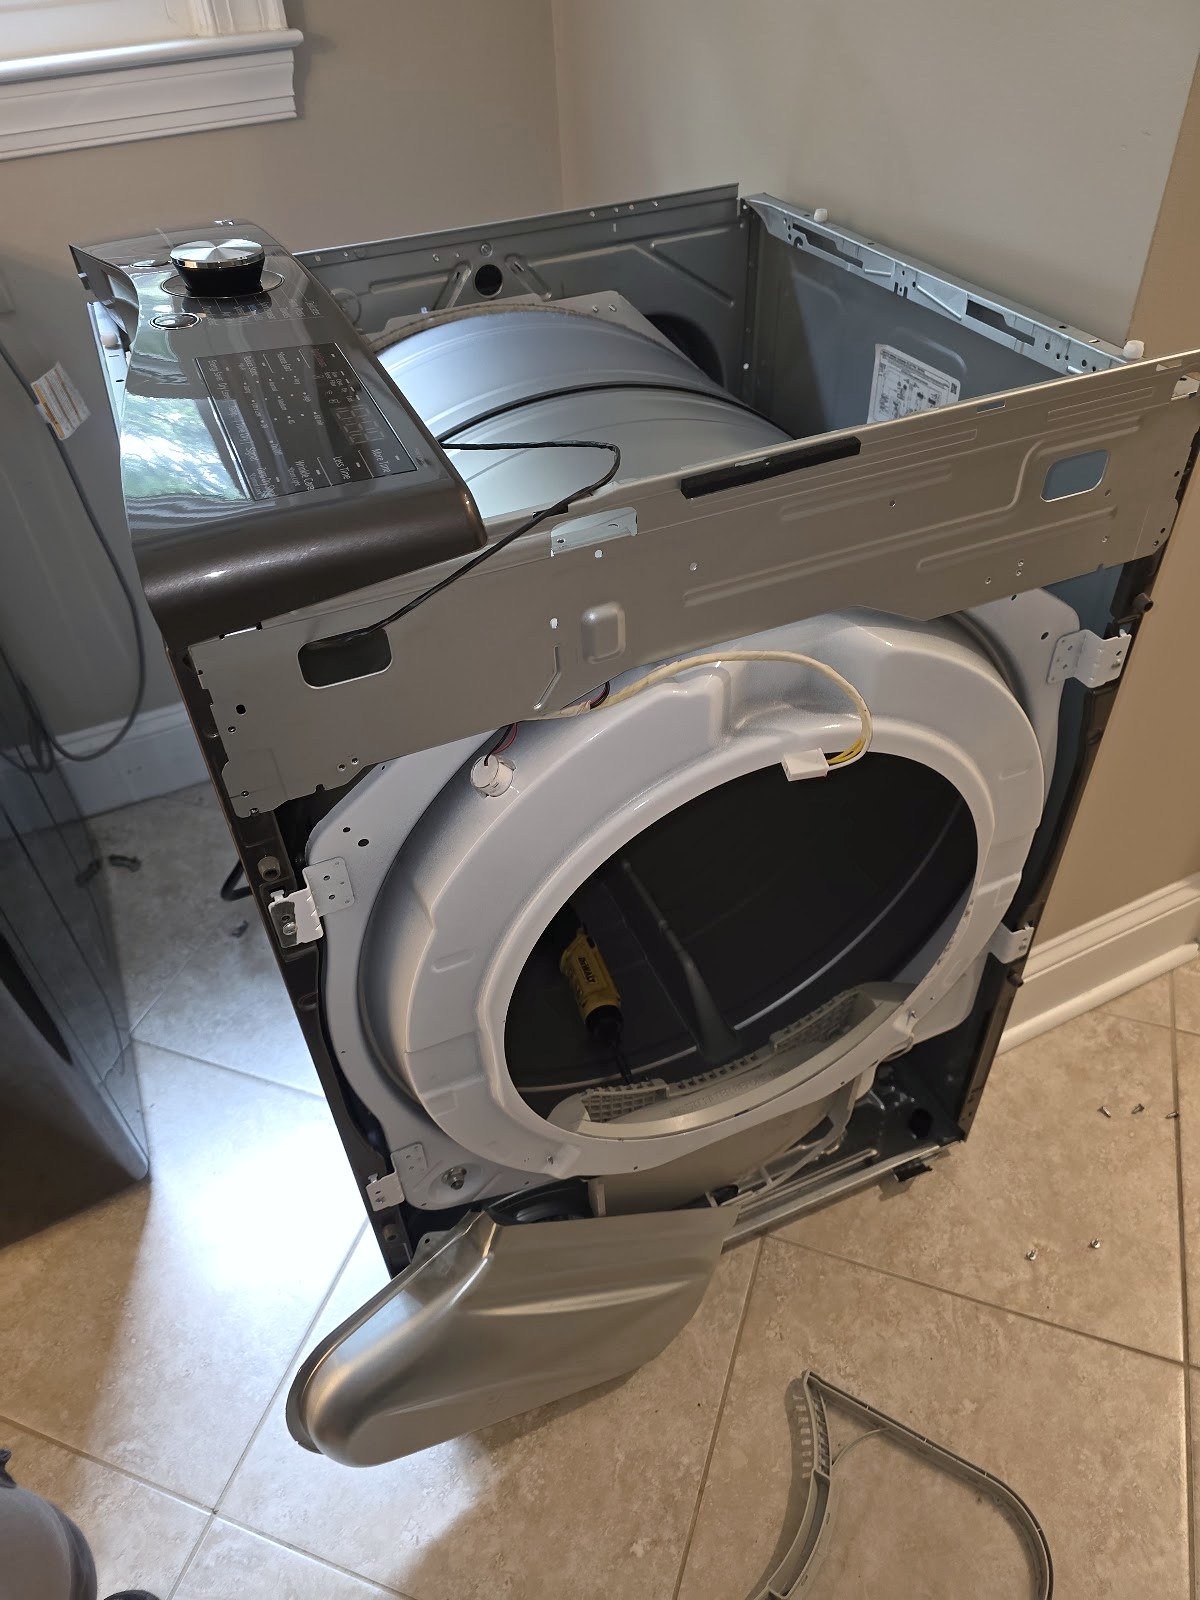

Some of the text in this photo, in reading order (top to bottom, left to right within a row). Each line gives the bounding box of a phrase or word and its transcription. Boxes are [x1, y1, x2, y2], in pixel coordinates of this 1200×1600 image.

[332, 455, 353, 479] Less Time
[370, 448, 393, 473] More Time
[294, 460, 317, 490] Wrinkle Care
[578, 956, 596, 984] DEWALT
